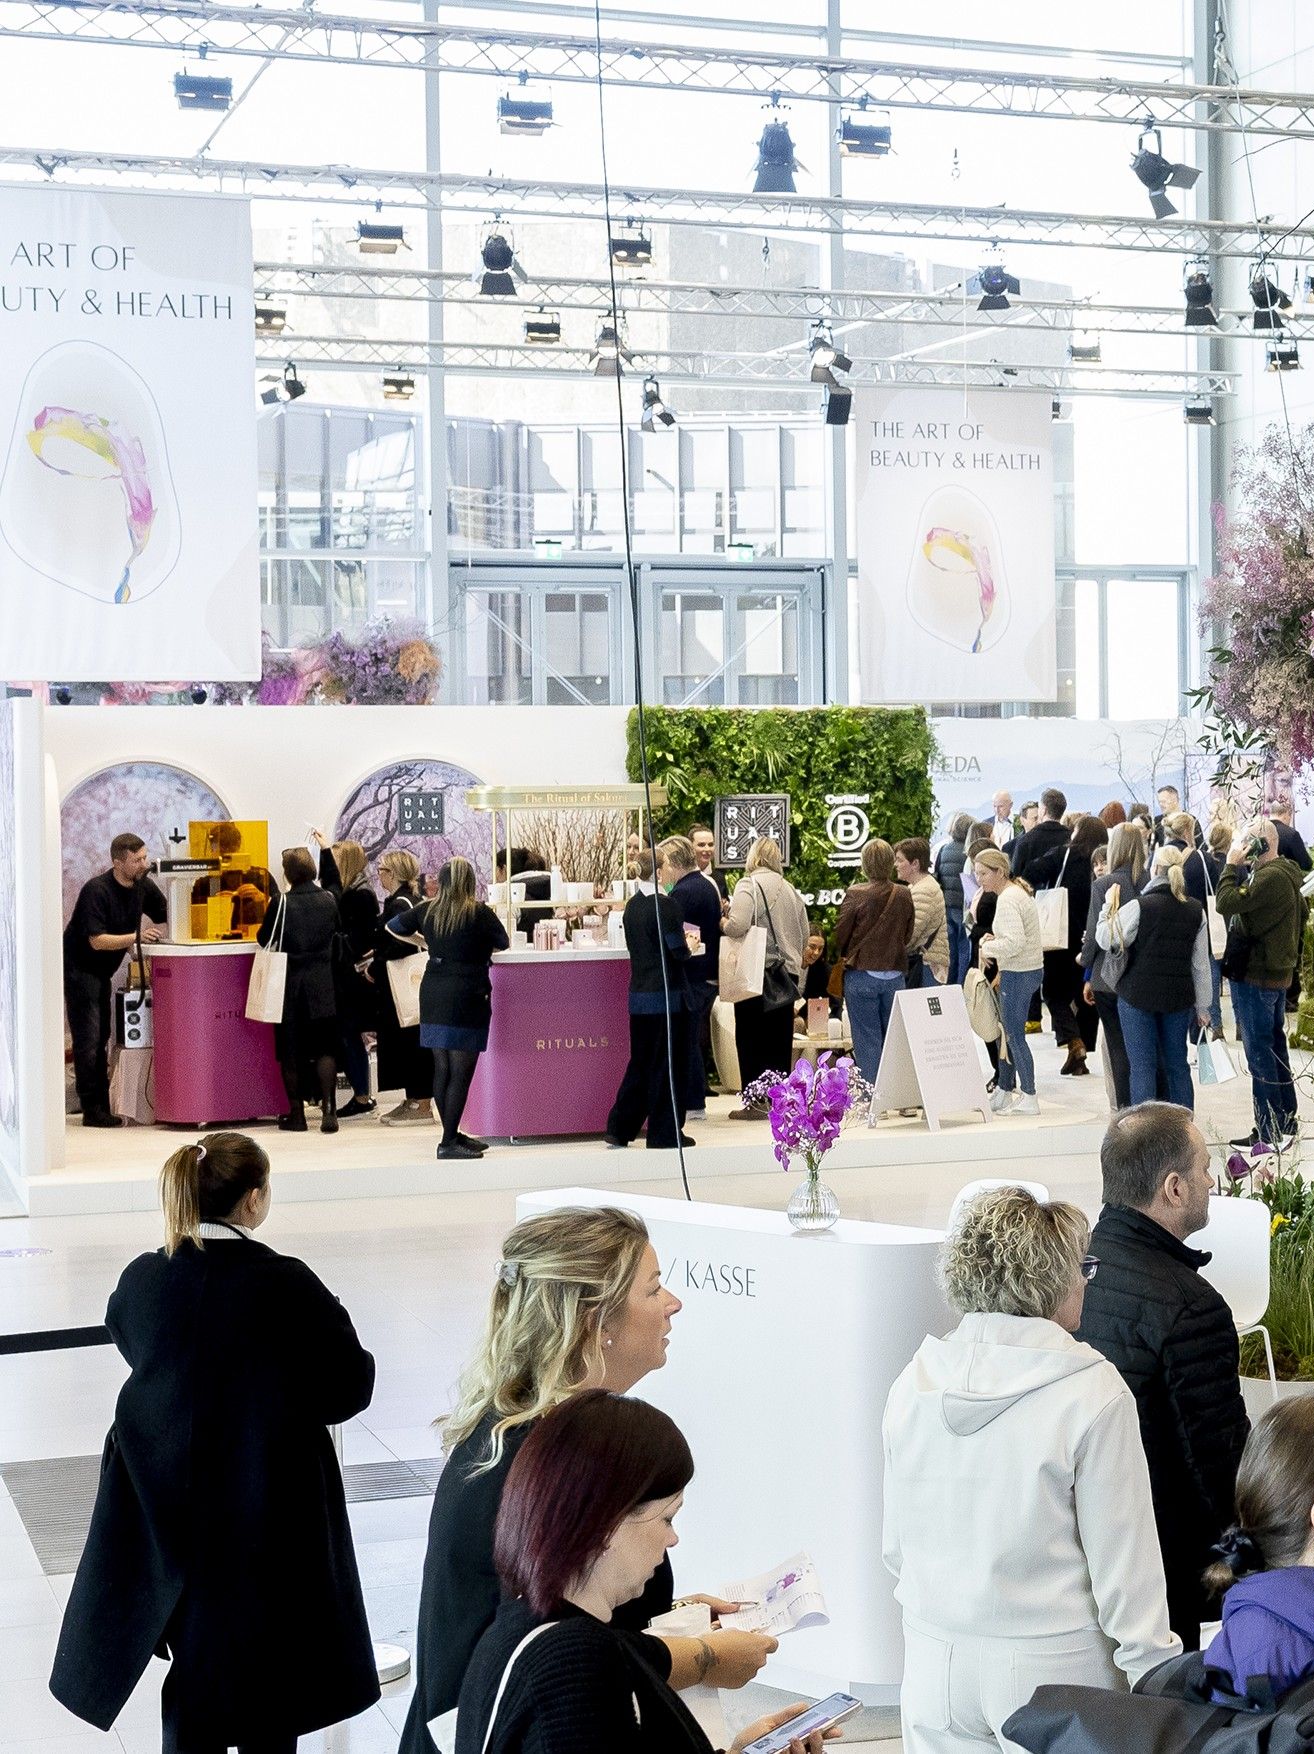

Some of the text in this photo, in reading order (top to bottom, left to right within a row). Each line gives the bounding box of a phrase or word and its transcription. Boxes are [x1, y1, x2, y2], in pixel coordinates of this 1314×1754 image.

[10, 241, 136, 271] ART OF
[2, 286, 232, 320] UTY & HEALTH
[869, 421, 985, 441] THE ART OF
[869, 450, 1041, 470] BEAUTY & HEALTH
[930, 755, 982, 773] LEDA
[837, 814, 860, 842] B
[536, 1036, 609, 1050] RITUALS
[686, 1260, 756, 1298] KASSE
